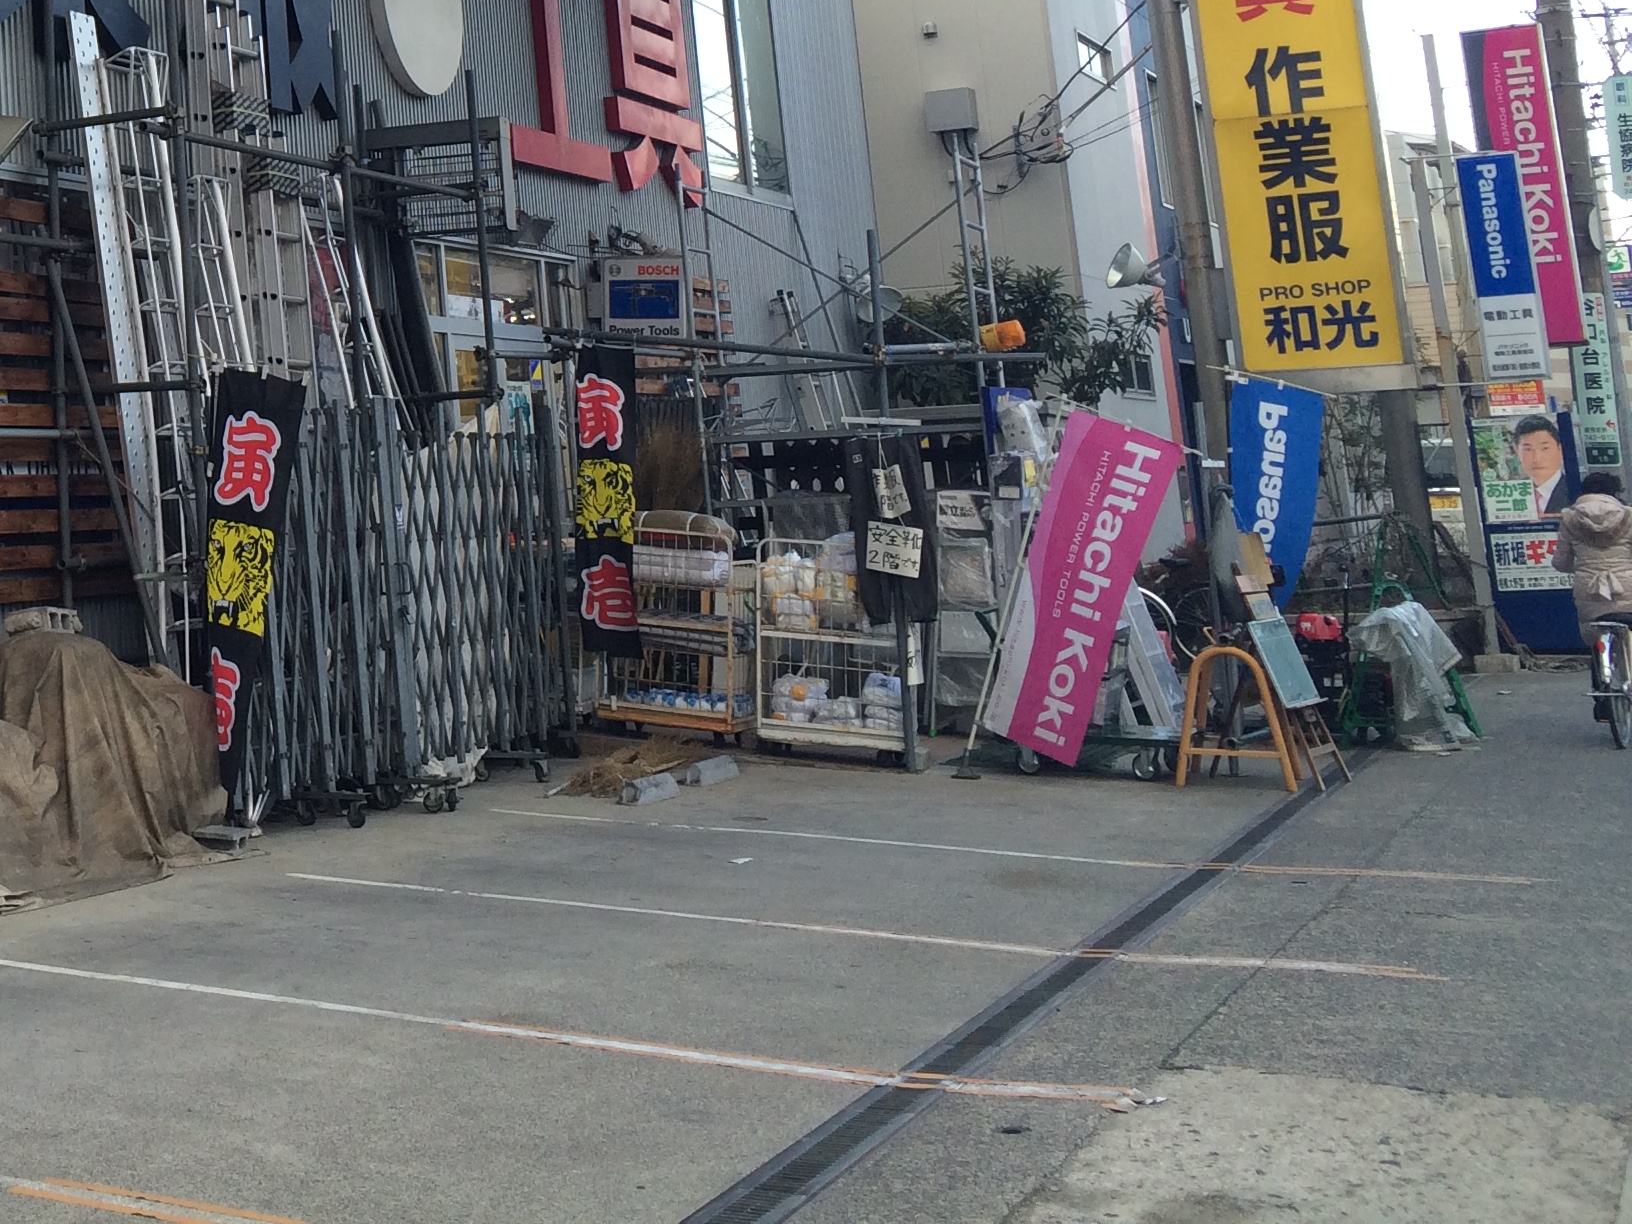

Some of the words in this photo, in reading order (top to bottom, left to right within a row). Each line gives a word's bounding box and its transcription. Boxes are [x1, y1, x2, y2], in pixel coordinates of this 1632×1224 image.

[1491, 61, 1504, 103] HITACHI
[1498, 107, 1511, 144] POWER
[1502, 47, 1550, 175] Hitachi
[1244, 45, 1349, 264] 作業服
[1475, 163, 1511, 280] Panasonic
[1524, 183, 1563, 265] Koki
[637, 265, 680, 276] BOSCH
[1258, 285, 1305, 302] PRO
[1311, 279, 1372, 298] SHOP
[609, 324, 646, 336] Power
[648, 325, 680, 337] Tools
[1262, 299, 1380, 354] 和光
[1482, 308, 1535, 322] 電動工具
[1087, 450, 1112, 507] HITACHI
[1253, 401, 1289, 554] Panaso
[1486, 481, 1533, 498] あかま
[1068, 512, 1090, 564] POWER
[1070, 440, 1162, 623] Hitachi
[1053, 569, 1072, 619] TOOLS
[1033, 628, 1095, 747] Koki
